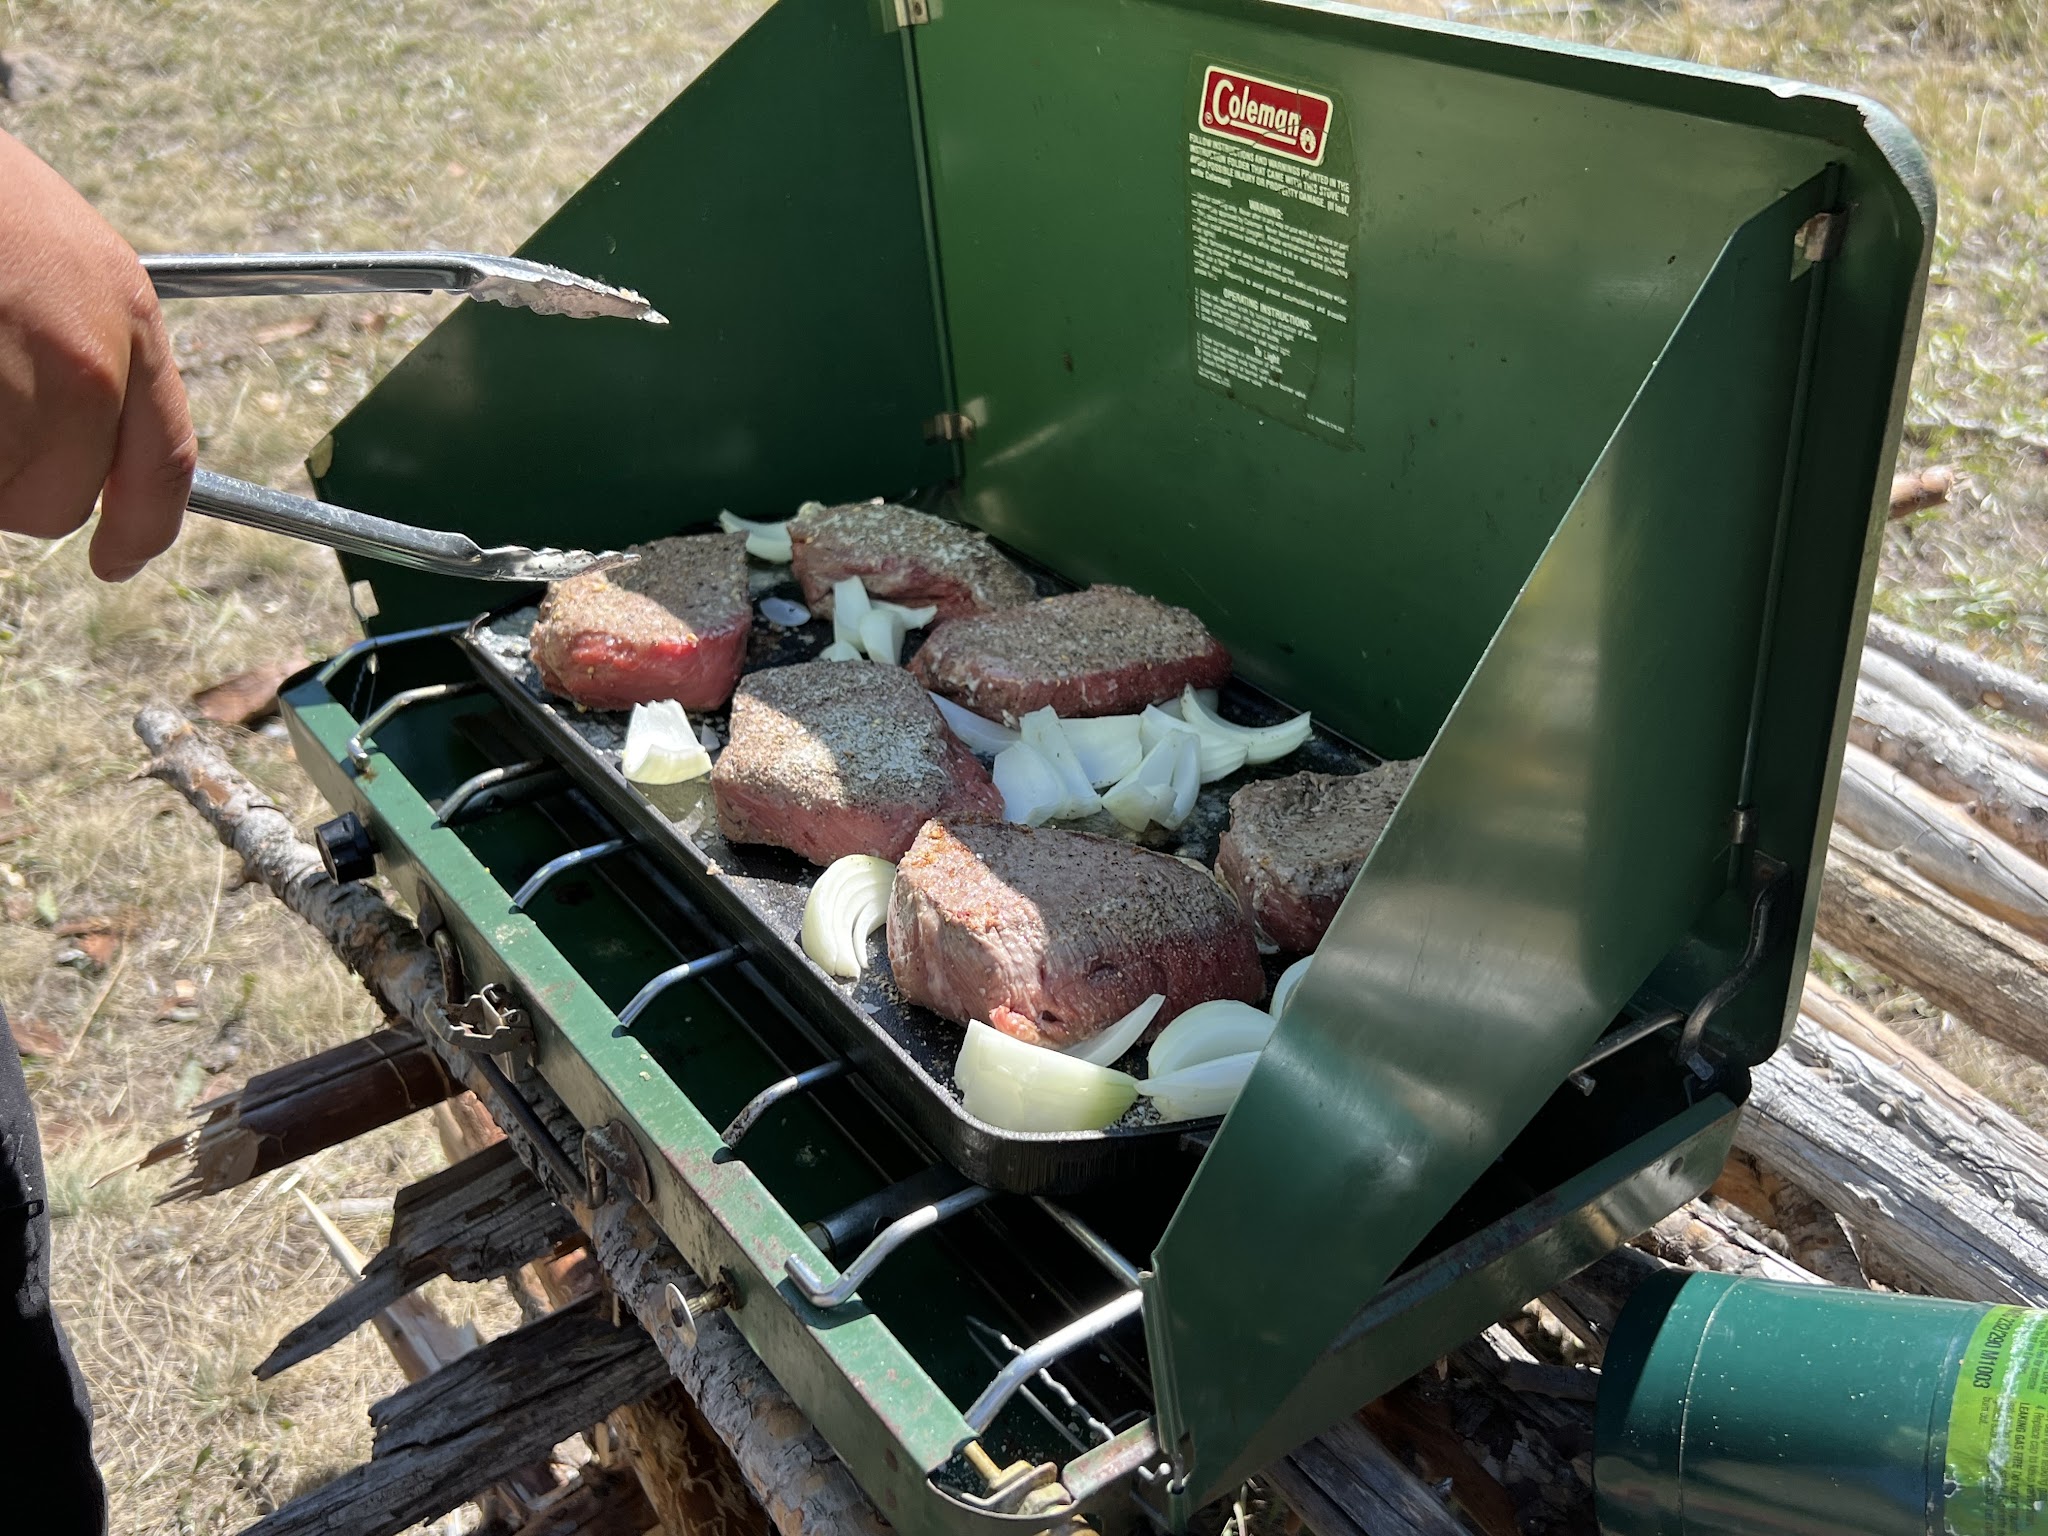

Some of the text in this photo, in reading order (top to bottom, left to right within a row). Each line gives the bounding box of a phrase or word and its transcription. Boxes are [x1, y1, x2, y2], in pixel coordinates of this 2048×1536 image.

[1212, 79, 1301, 138] Coleman
[1226, 156, 1249, 171] FOLDER
[1250, 164, 1265, 176] THAT
[1266, 169, 1283, 182] CAME
[1303, 181, 1317, 193] THIS
[1318, 185, 1338, 201] STOVE
[1340, 193, 1349, 204] TO
[1235, 169, 1255, 184] INJURY
[1255, 176, 1264, 187] OR
[1255, 154, 1267, 166] AND
[1267, 158, 1299, 176] WARNINGS
[1329, 177, 1336, 187] IN
[1337, 180, 1349, 193] THE
[1223, 287, 1258, 310] OPERATING
[1973, 1350, 1999, 1389] M1003
[2016, 1402, 2030, 1433] LEAKING
[2031, 1412, 2044, 1439] Replace
[2014, 1434, 2025, 1450] GAS
[2028, 1441, 2039, 1454] cap
[2013, 1452, 2024, 1469] FIRE
[2029, 1455, 2039, 1463] to
